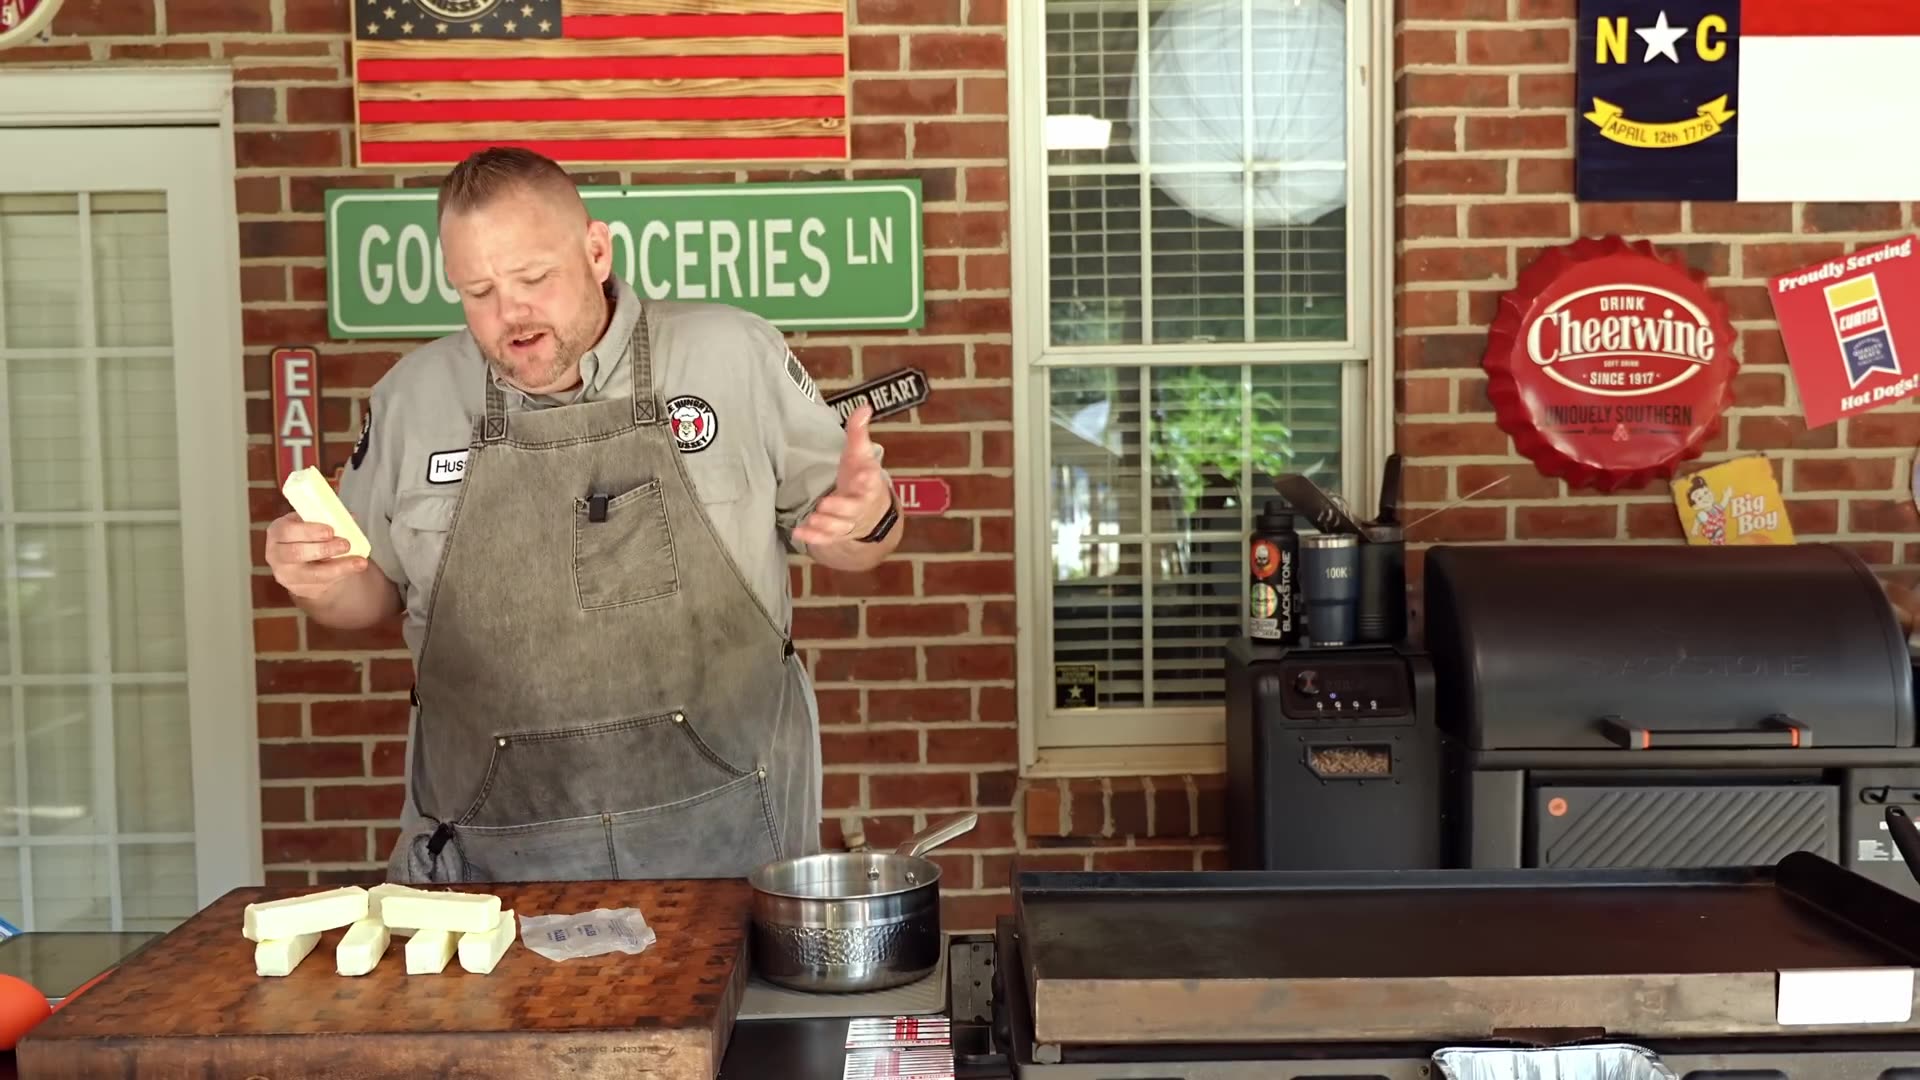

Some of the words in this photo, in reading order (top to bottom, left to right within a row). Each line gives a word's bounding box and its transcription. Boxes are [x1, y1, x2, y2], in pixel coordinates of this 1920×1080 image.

[1596, 16, 1628, 64] N
[1695, 14, 1728, 62] C
[1608, 121, 1647, 143] APRIL
[1653, 131, 1678, 144] 12th
[1683, 120, 1714, 141] 1776
[358, 223, 461, 305] GO
[608, 217, 830, 300] OCERIES
[847, 216, 894, 265] LN
[1778, 262, 1845, 293] Proudly
[1846, 239, 1912, 271] Serving
[1600, 296, 1645, 312] DRINK
[1839, 306, 1879, 332] CURTIS
[1527, 308, 1715, 366] Cheerwine
[1589, 372, 1625, 385] SINCE
[1629, 371, 1655, 385] 1917
[869, 375, 919, 411] HEART
[1841, 393, 1871, 412] Hot
[1873, 373, 1919, 402] Dogs!
[281, 358, 313, 472] EAT
[1545, 405, 1612, 425] UNIQUELY
[1615, 405, 1693, 426] SOUTHERN
[677, 436, 708, 449] USSEY
[435, 459, 467, 473] Hus
[1731, 493, 1764, 518] Big
[1738, 511, 1777, 535] Boy
[1325, 566, 1348, 579] 100K
[1282, 550, 1292, 633] BLACKSTONE
